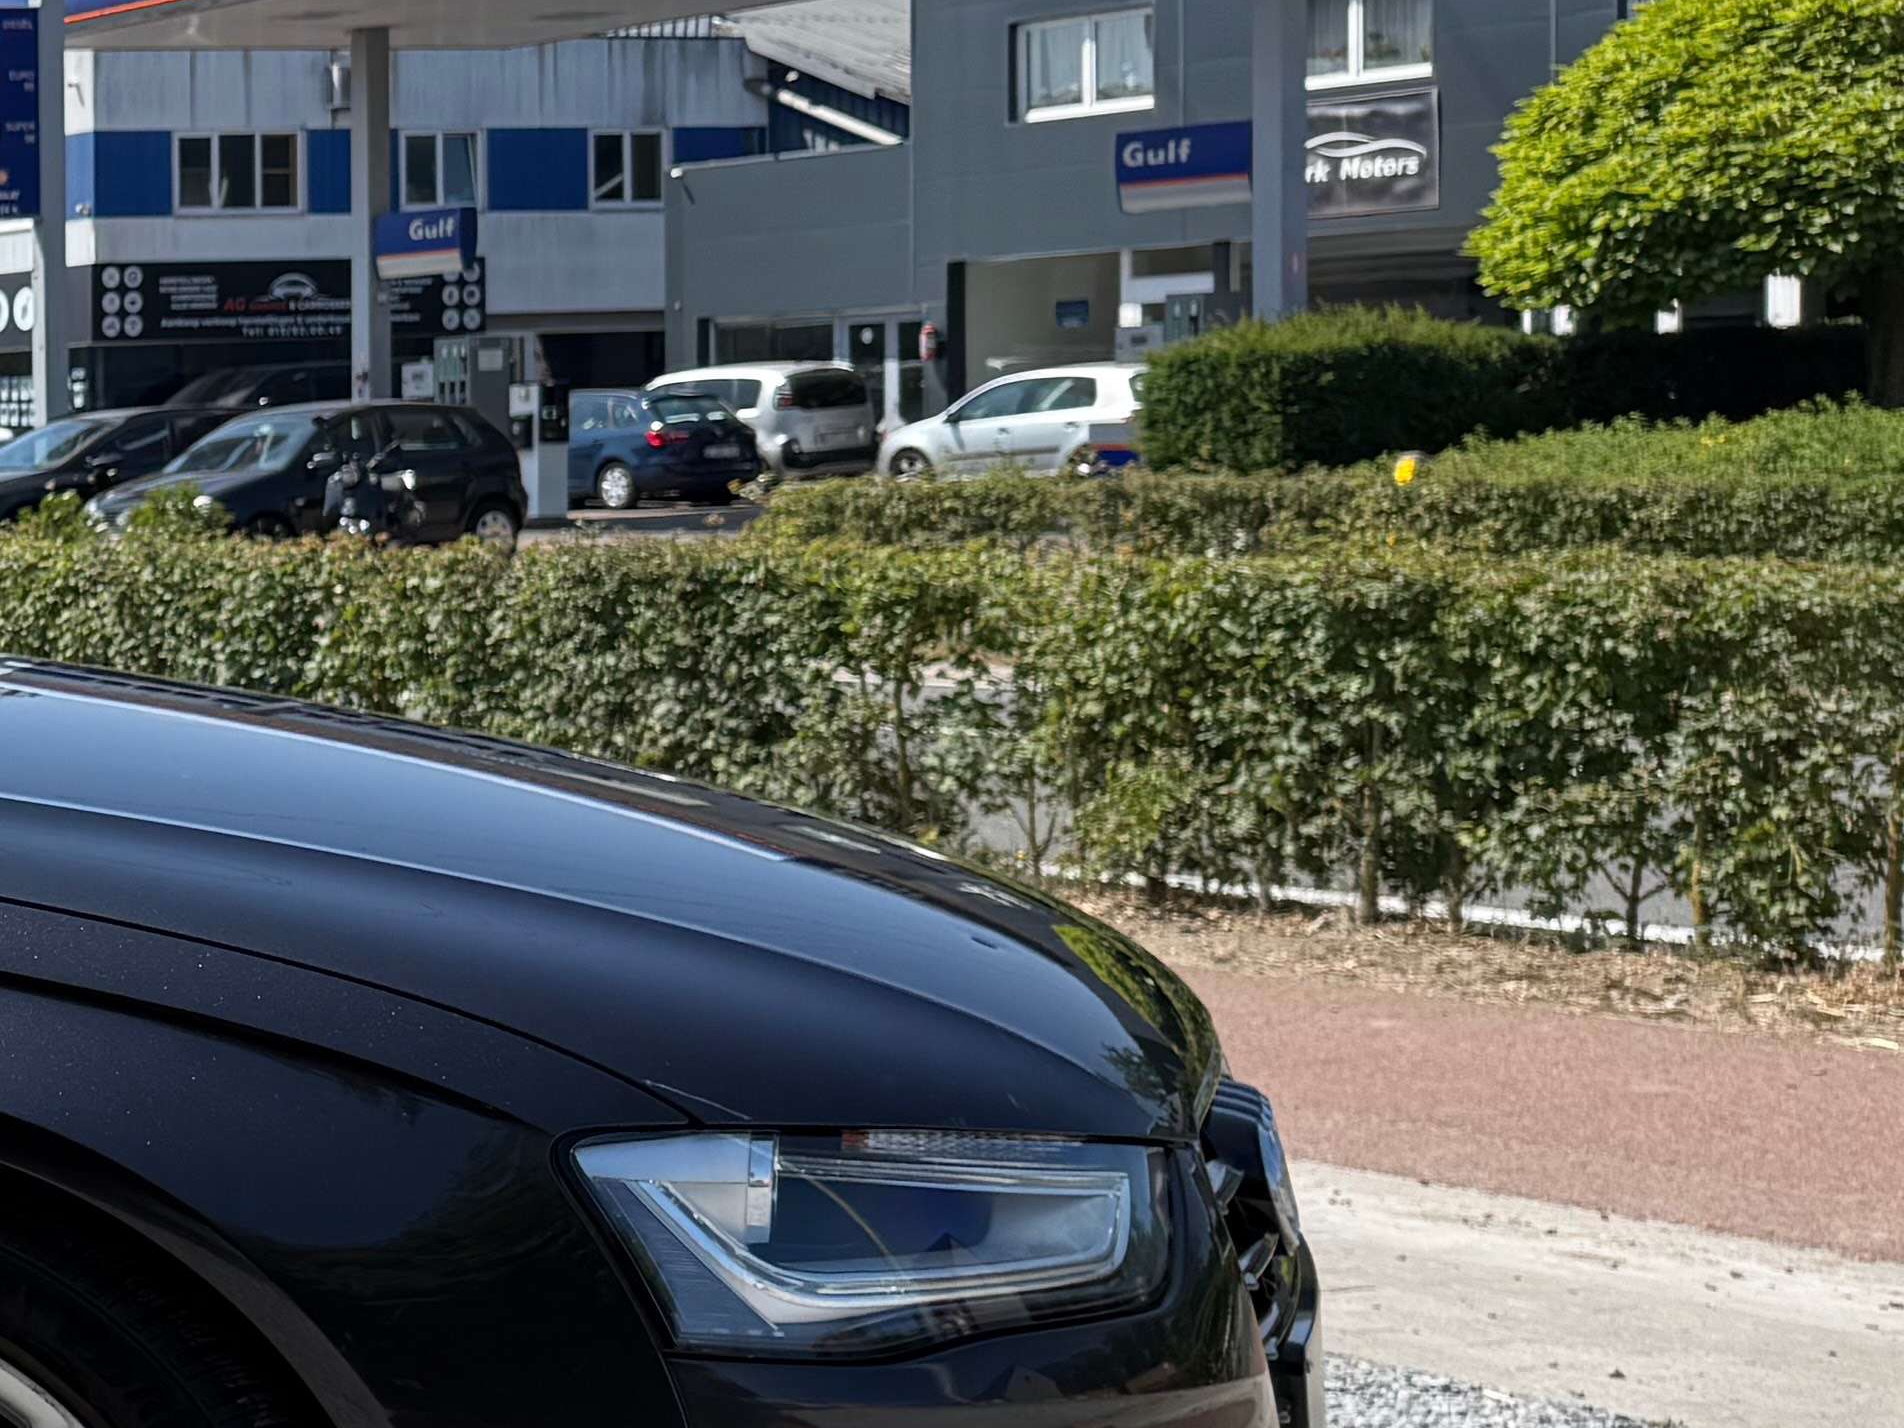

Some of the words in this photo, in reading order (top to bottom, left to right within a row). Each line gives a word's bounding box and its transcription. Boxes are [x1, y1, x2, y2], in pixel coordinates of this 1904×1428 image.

[1123, 138, 1191, 168] Gulf
[1305, 159, 1331, 183] rk
[1339, 156, 1419, 180] Motors
[408, 216, 455, 241] Gulf
